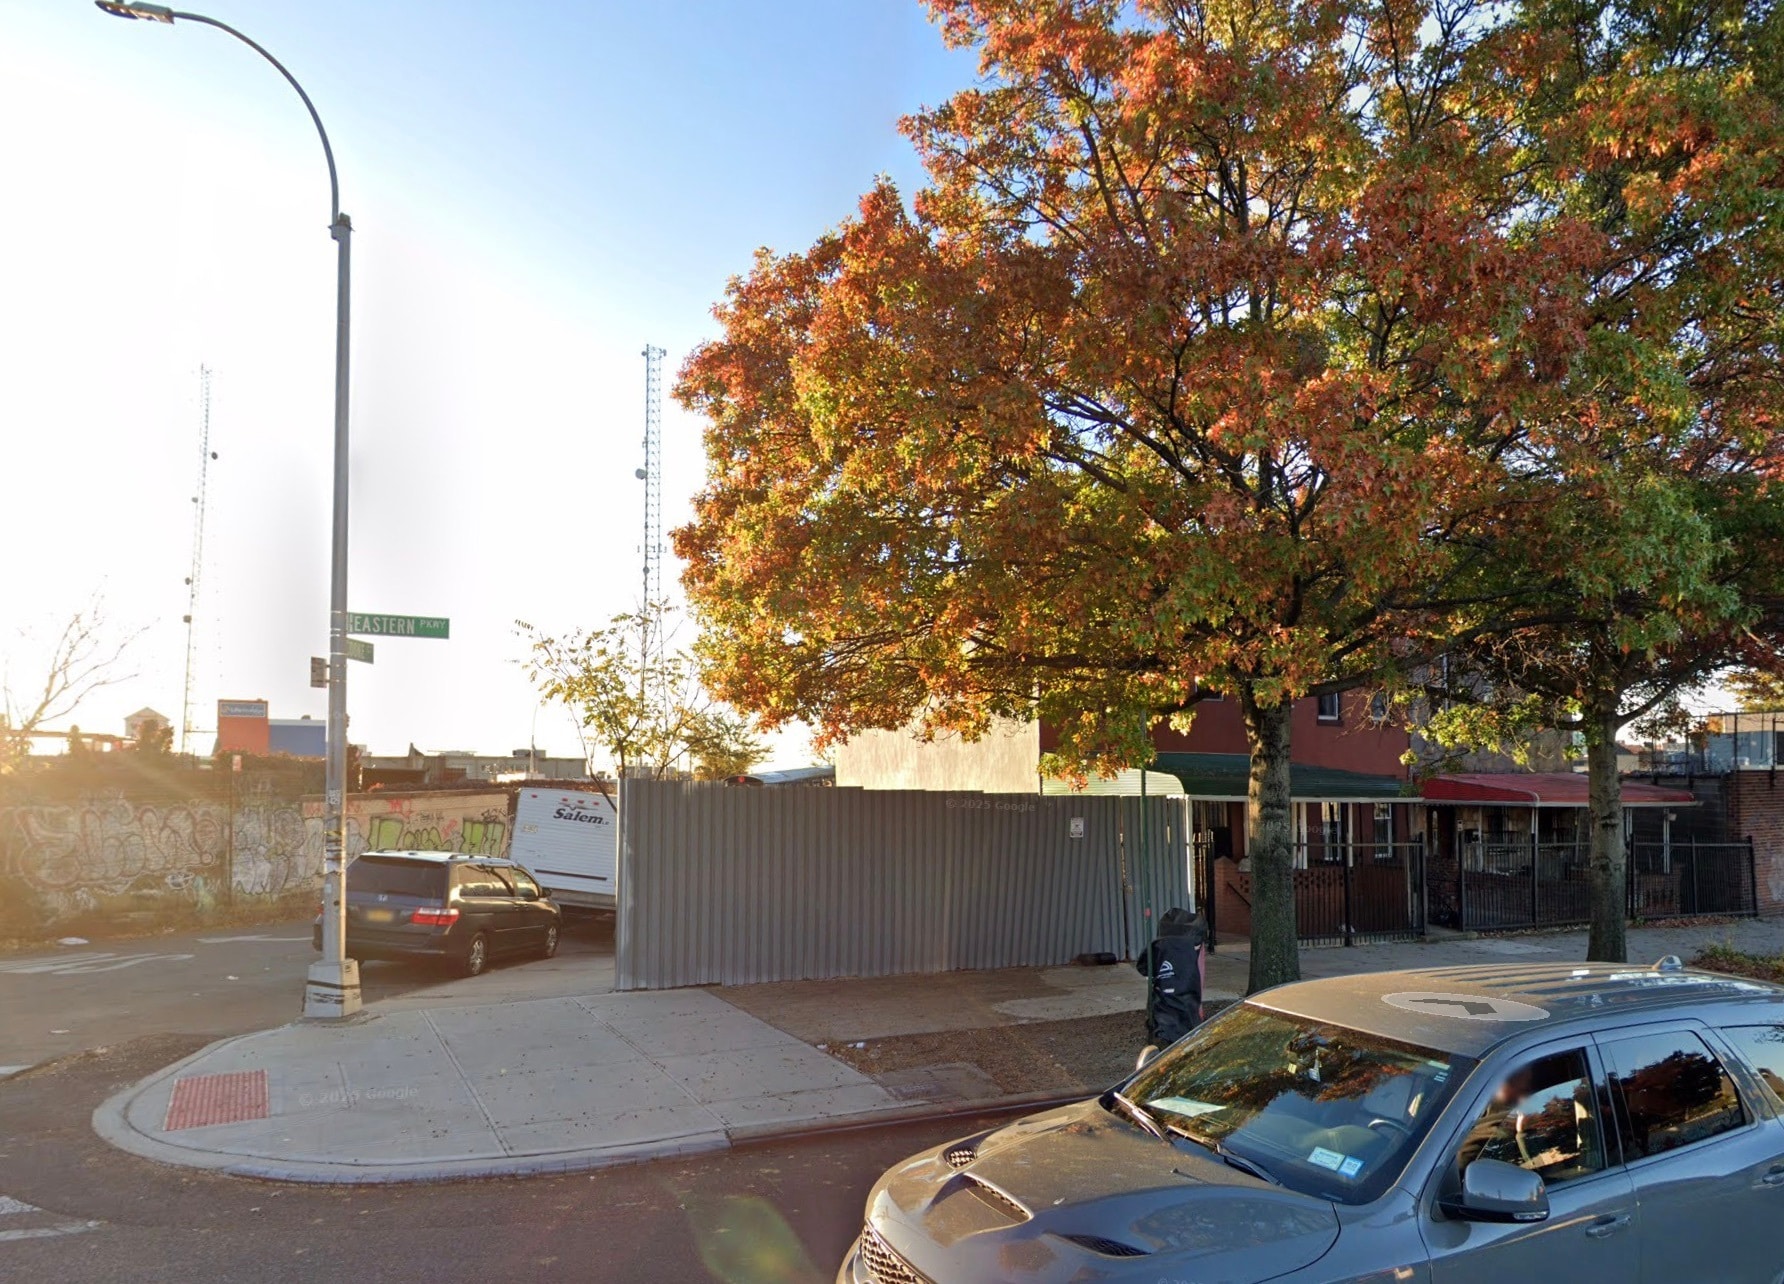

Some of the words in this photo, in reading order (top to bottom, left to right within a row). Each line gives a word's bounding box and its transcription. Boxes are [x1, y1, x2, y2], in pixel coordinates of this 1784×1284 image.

[354, 616, 415, 635] EASTERN
[420, 619, 446, 629] PKWY
[553, 807, 604, 825] Salem
